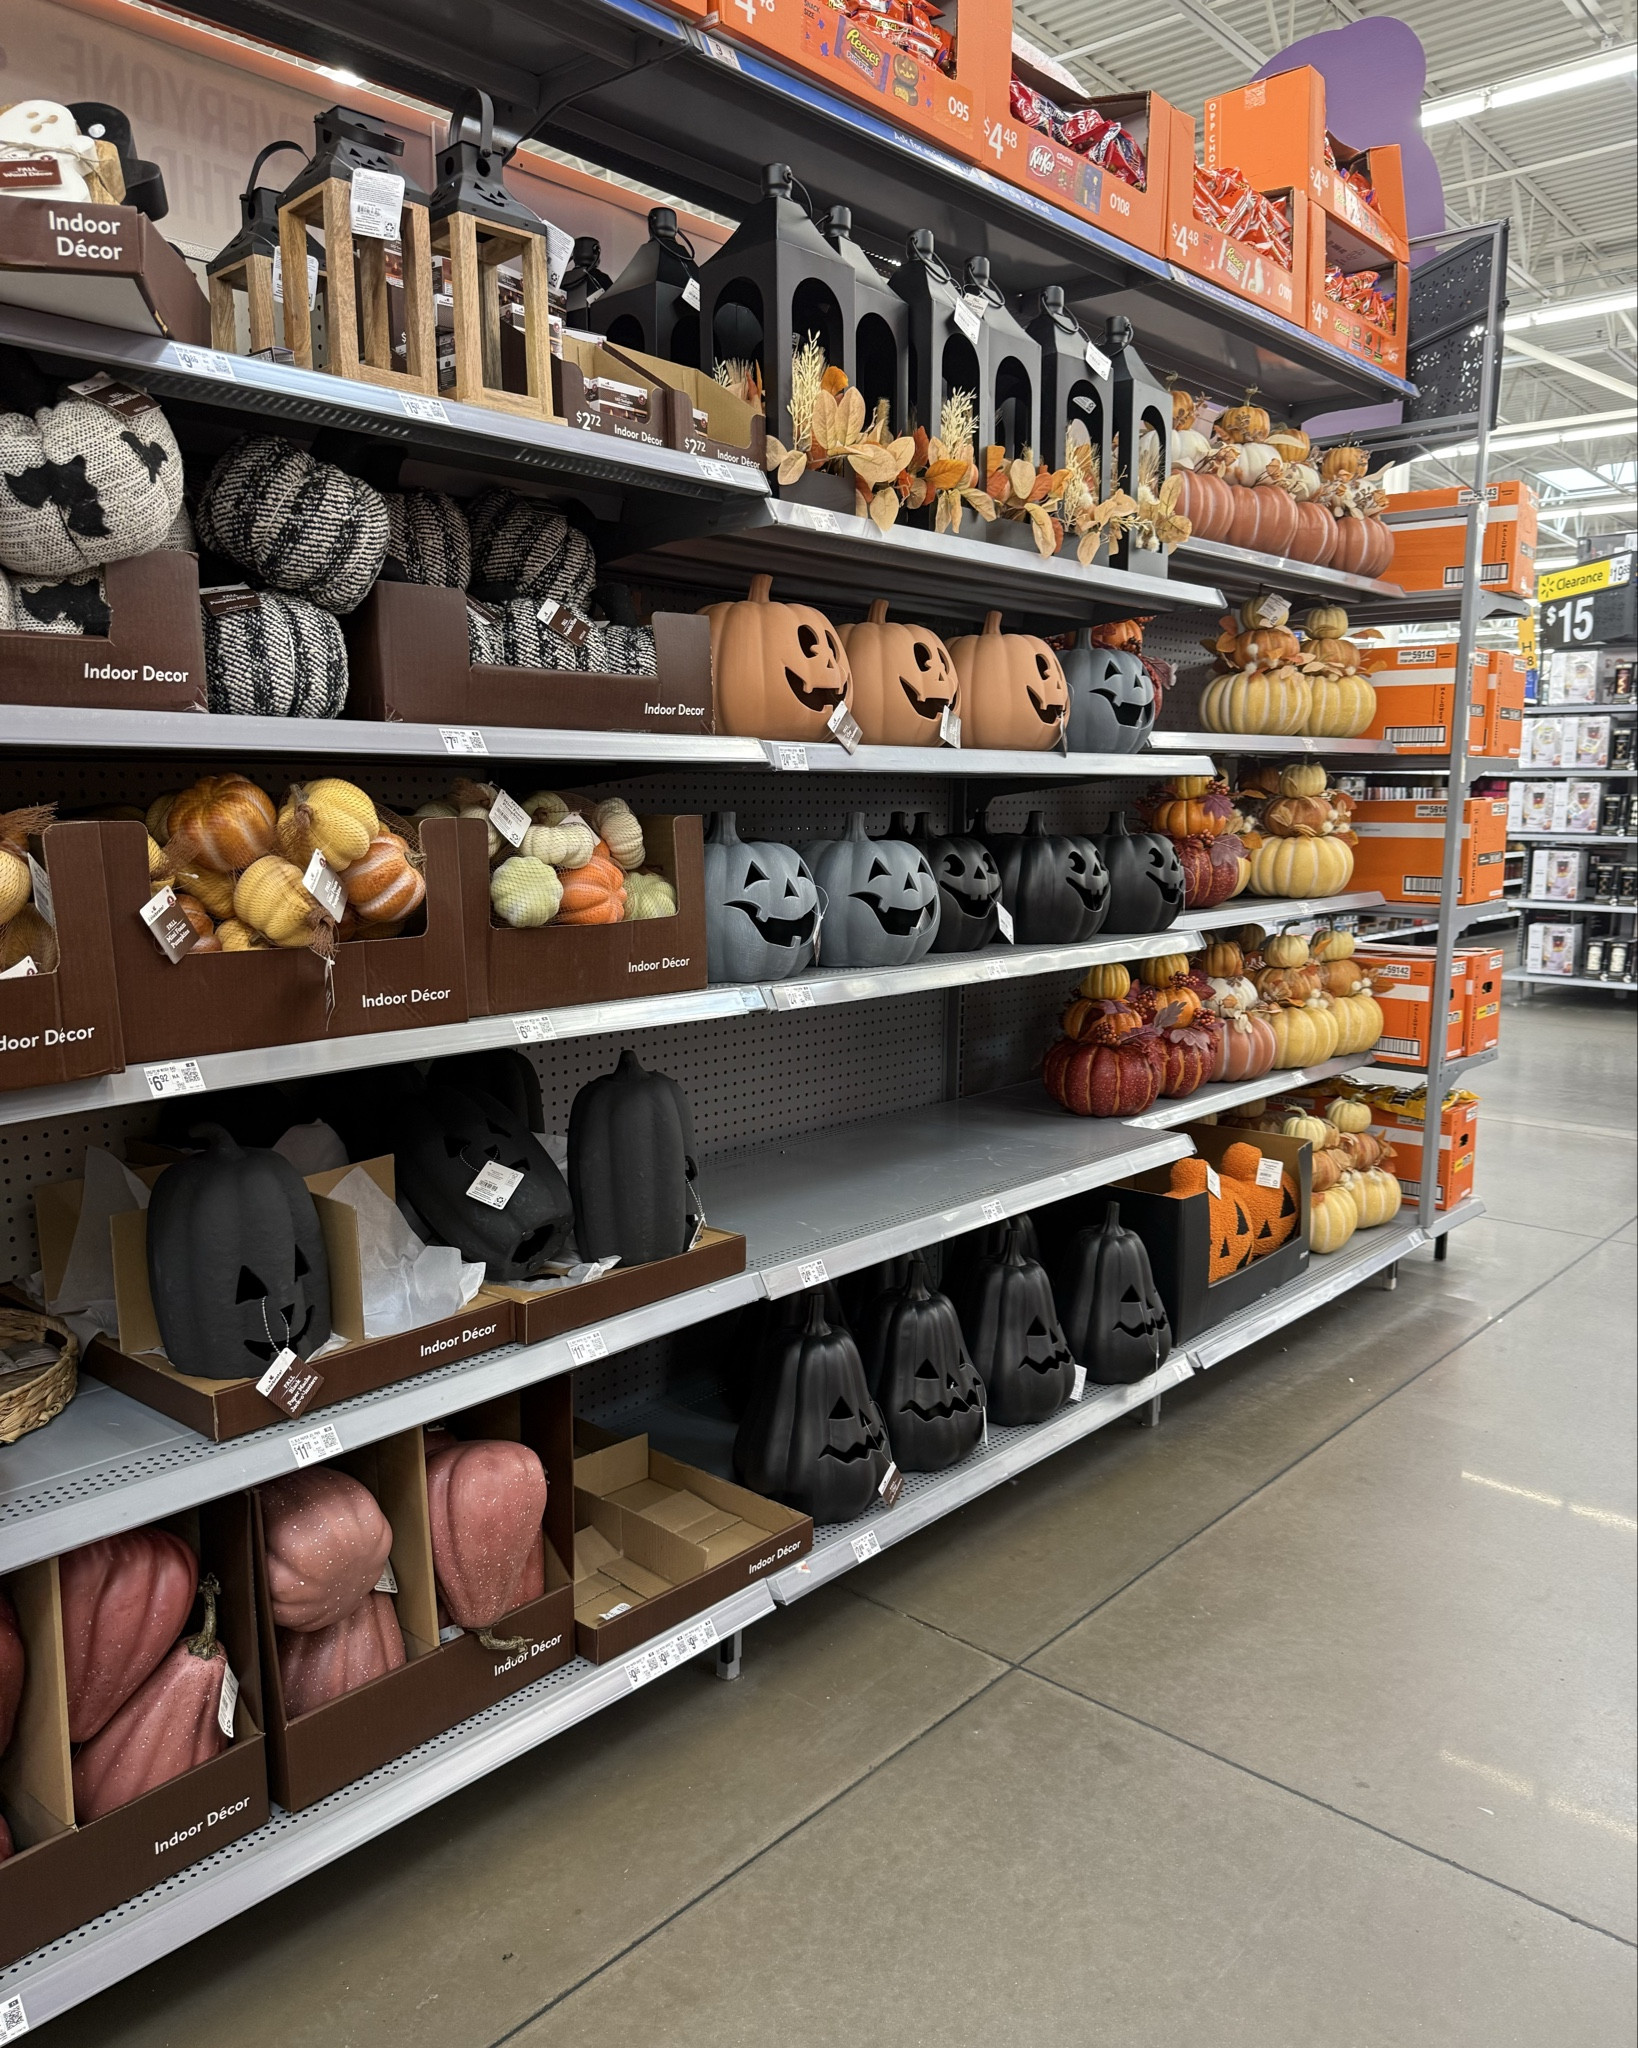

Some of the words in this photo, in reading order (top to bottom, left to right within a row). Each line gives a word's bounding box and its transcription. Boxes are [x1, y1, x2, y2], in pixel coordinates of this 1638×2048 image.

[846, 28, 880, 67] Reese's
[48, 209, 121, 235] Indoor
[56, 236, 123, 260] Décor
[614, 424, 640, 441] Indoor
[641, 431, 663, 447] Décor
[717, 449, 740, 464] Indoor
[741, 454, 762, 470] Décor
[1556, 571, 1604, 591] Clearance
[1545, 596, 1595, 643] $15
[84, 662, 139, 681] Indoor
[142, 665, 190, 683] Decor
[644, 703, 677, 716] Indoor
[677, 703, 706, 716] Decor
[628, 959, 660, 974] Indoor
[662, 956, 691, 970] Décor
[362, 993, 408, 1009] Indoor
[411, 987, 451, 1003] Décor
[0, 1035, 40, 1051] door
[44, 1026, 96, 1047] Décor
[420, 1335, 460, 1358] Indoor
[462, 1322, 498, 1344] Décor
[748, 1553, 776, 1575] Indoor
[776, 1539, 802, 1560] Décor
[493, 1651, 529, 1677] Indoor
[530, 1632, 563, 1656] Décor
[154, 1821, 204, 1855] Indoor
[206, 1796, 251, 1828] Décor
